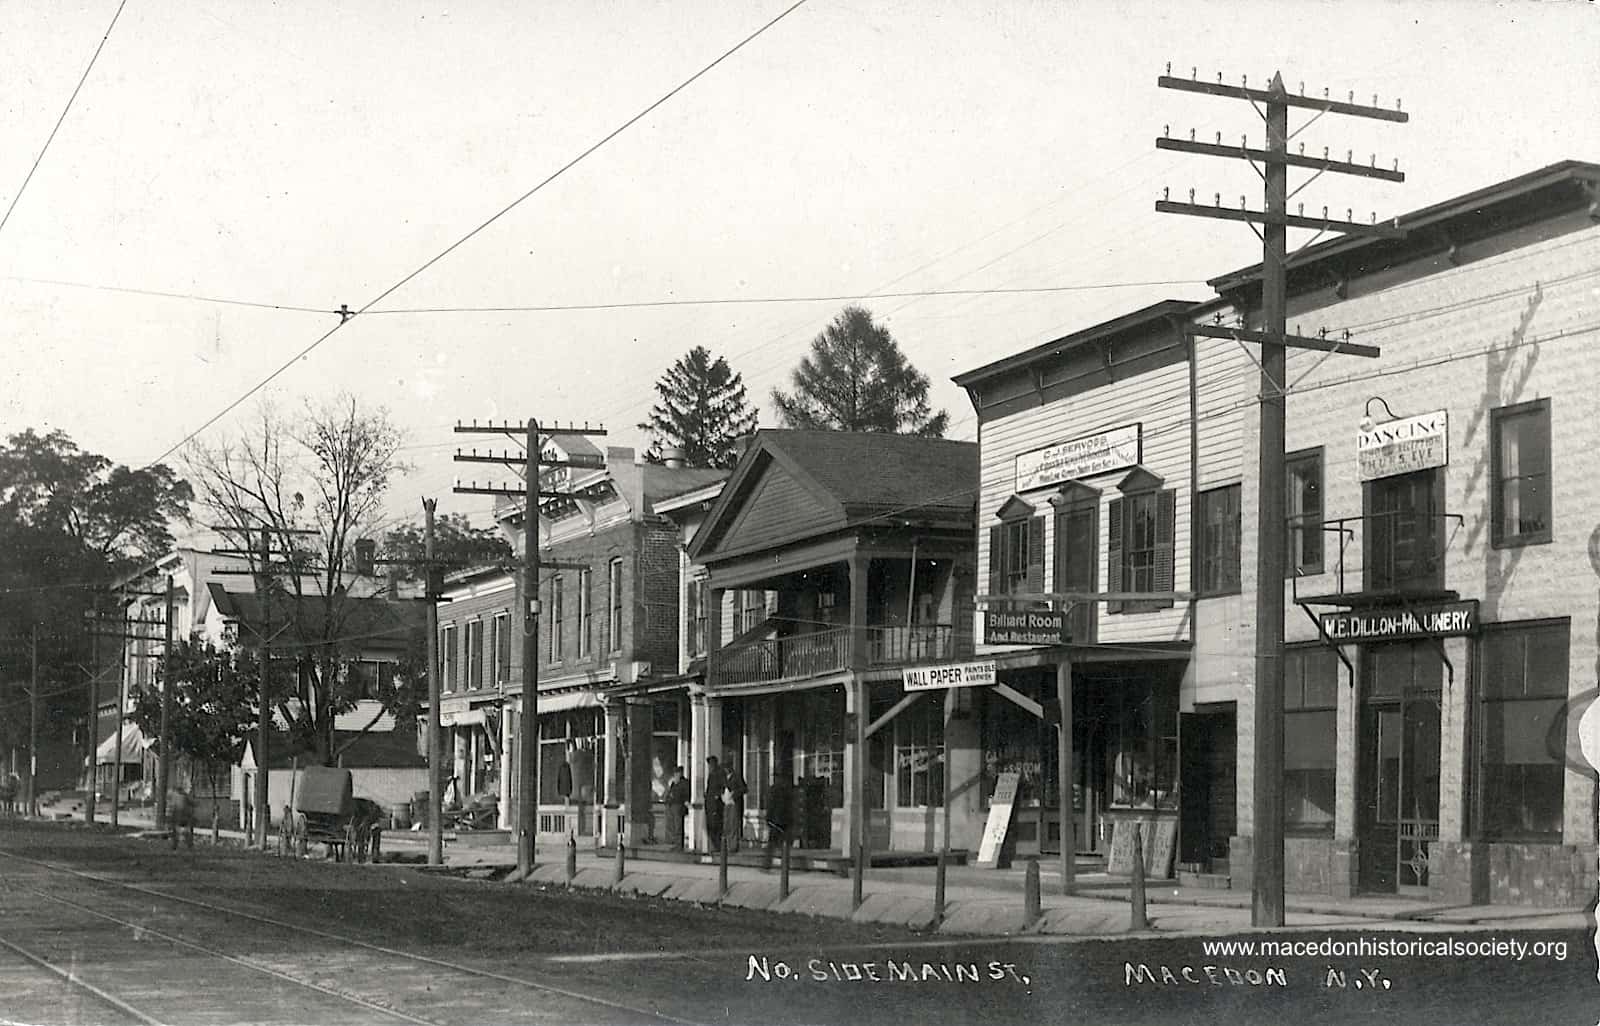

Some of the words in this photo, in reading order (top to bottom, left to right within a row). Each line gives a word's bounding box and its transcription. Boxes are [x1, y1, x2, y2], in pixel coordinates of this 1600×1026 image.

[1359, 420, 1445, 449] DANCING
[990, 614, 1027, 628] Billiard
[1029, 614, 1062, 629] Room
[906, 671, 929, 688] WALL
[930, 668, 962, 686] PAPER
